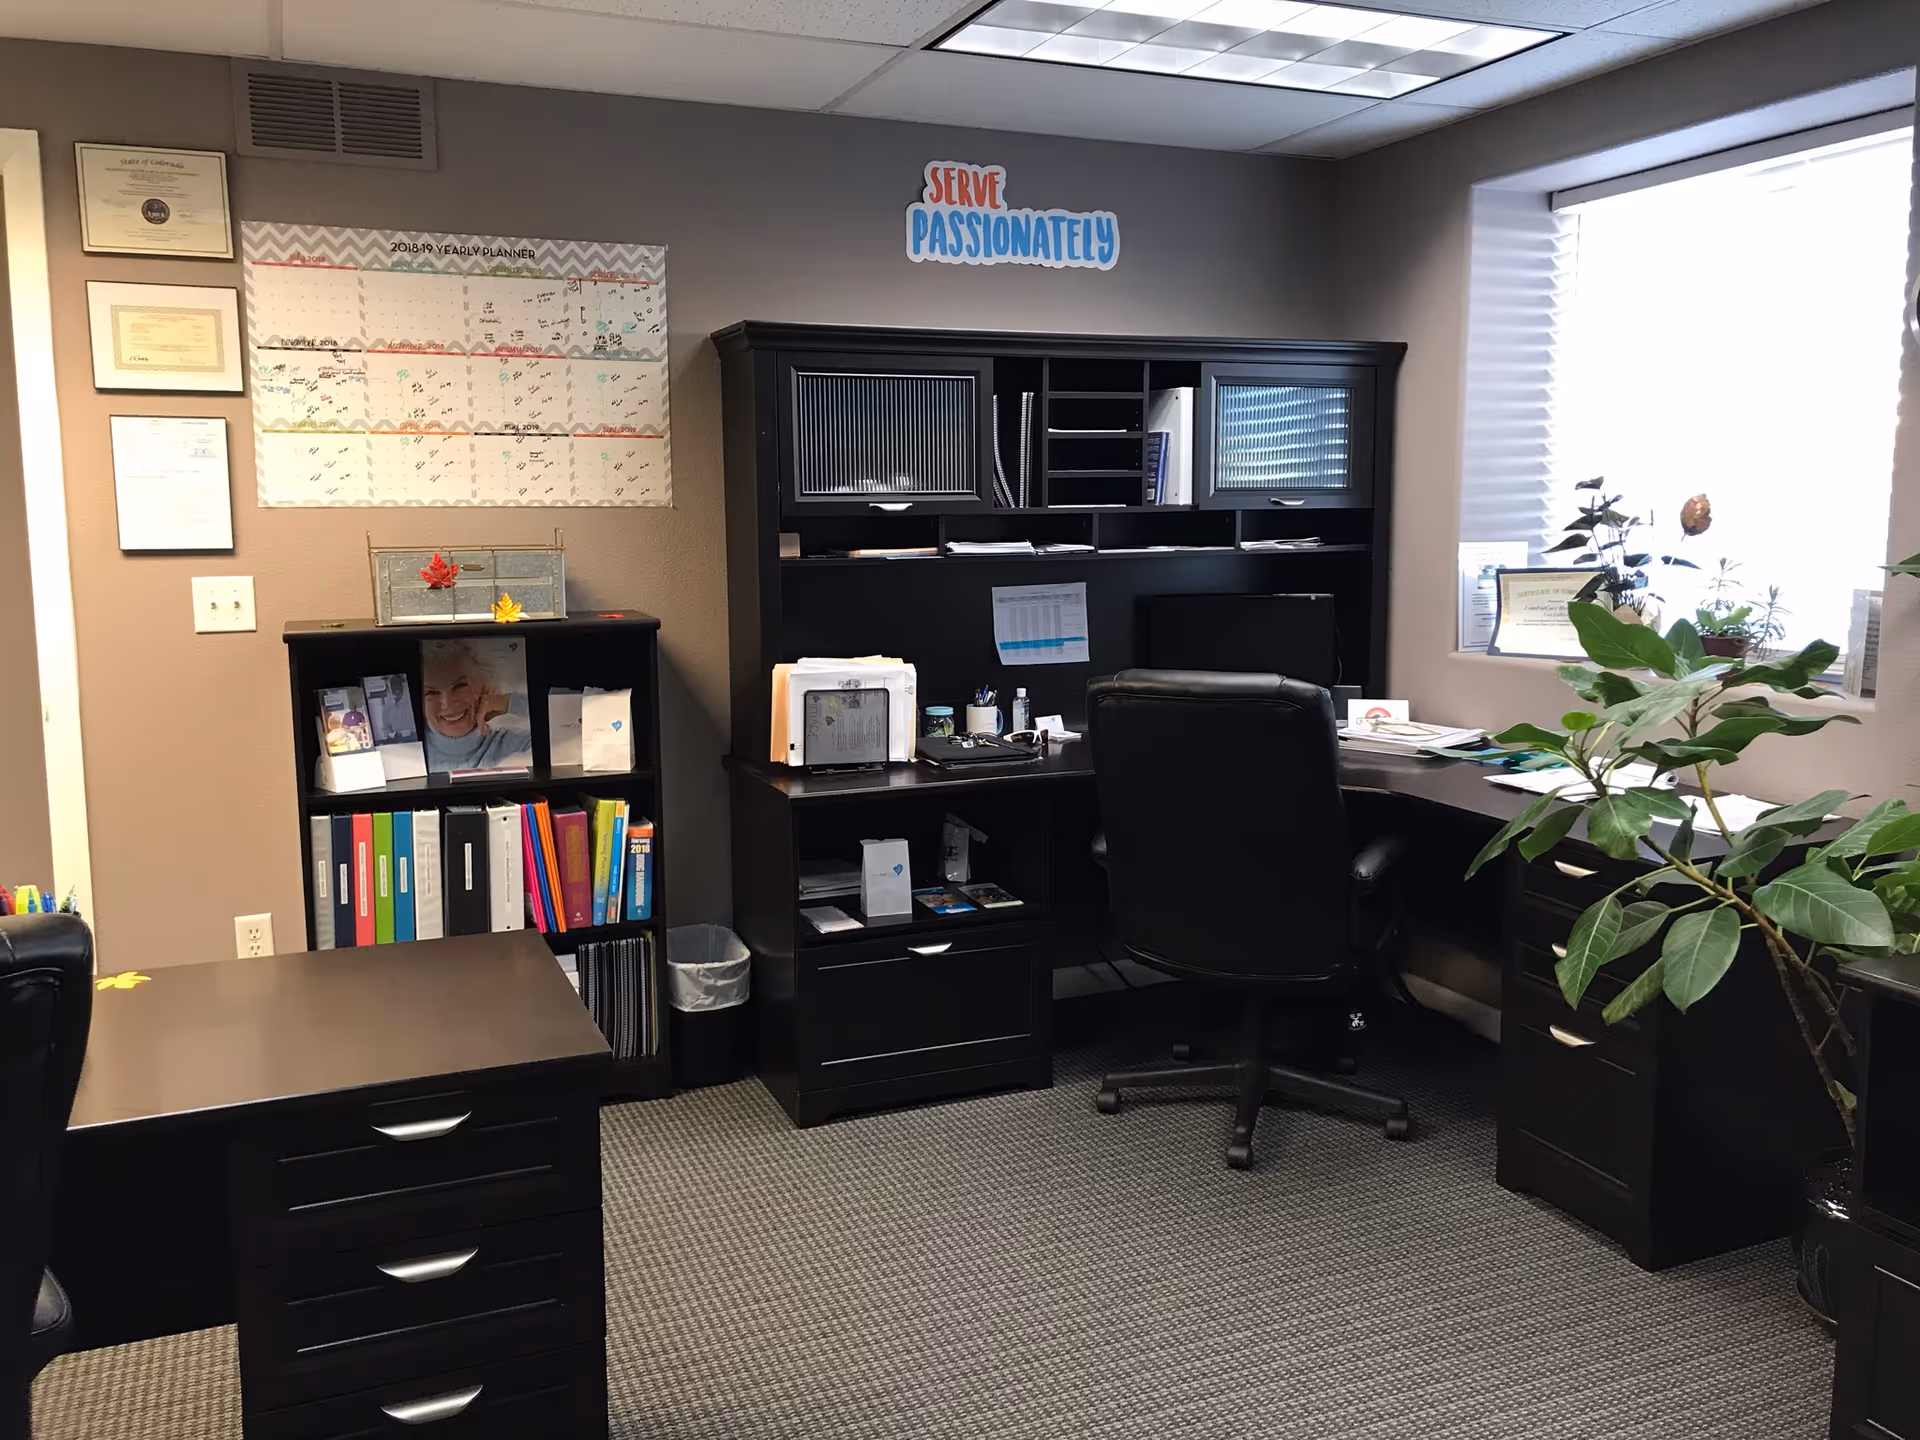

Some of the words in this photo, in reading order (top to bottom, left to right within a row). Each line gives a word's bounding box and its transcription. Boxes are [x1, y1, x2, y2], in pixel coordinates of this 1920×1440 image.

[150, 159, 185, 169] Colorado
[929, 166, 1001, 209] SERVE
[912, 208, 1114, 264] PASSIONATELY
[435, 244, 480, 257] YEARLY
[482, 247, 536, 260] PLANNER
[319, 339, 338, 347] 2018
